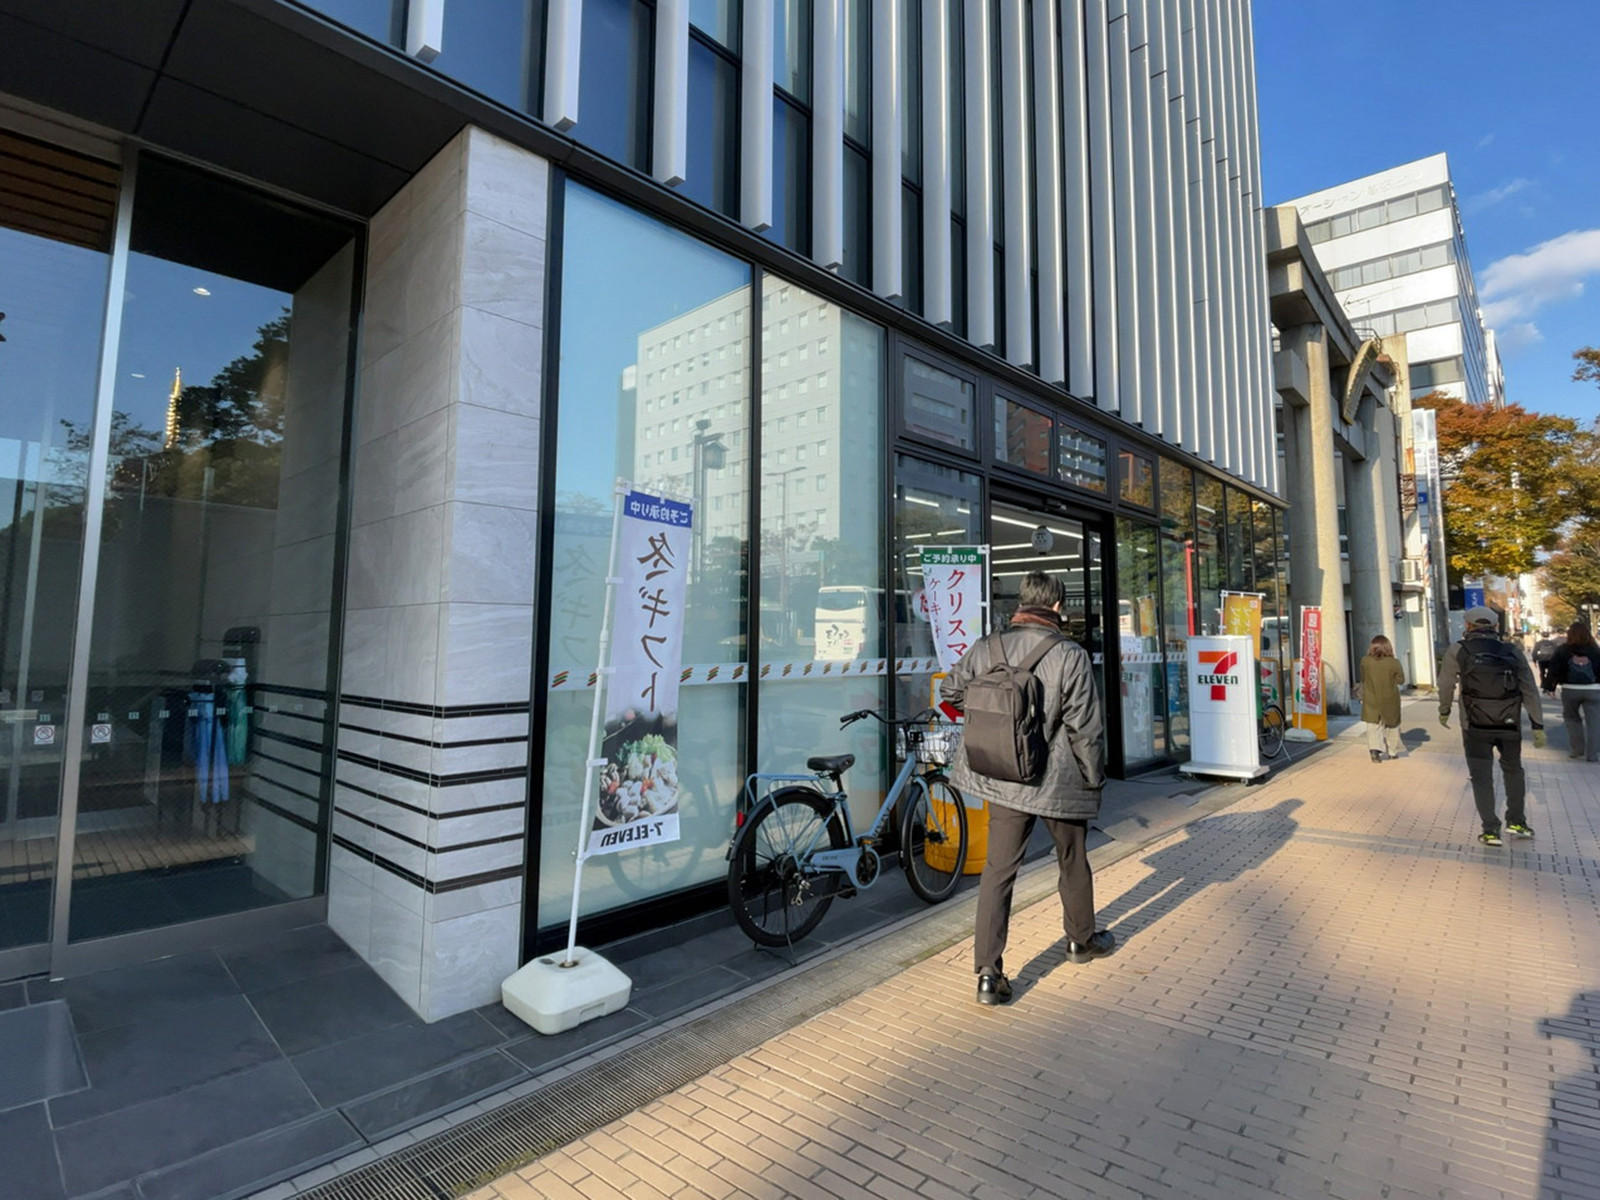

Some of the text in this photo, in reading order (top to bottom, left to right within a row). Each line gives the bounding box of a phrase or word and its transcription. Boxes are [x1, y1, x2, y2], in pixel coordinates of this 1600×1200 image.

[923, 553, 977, 564] ご予約承り中
[946, 568, 968, 668] クリスマ
